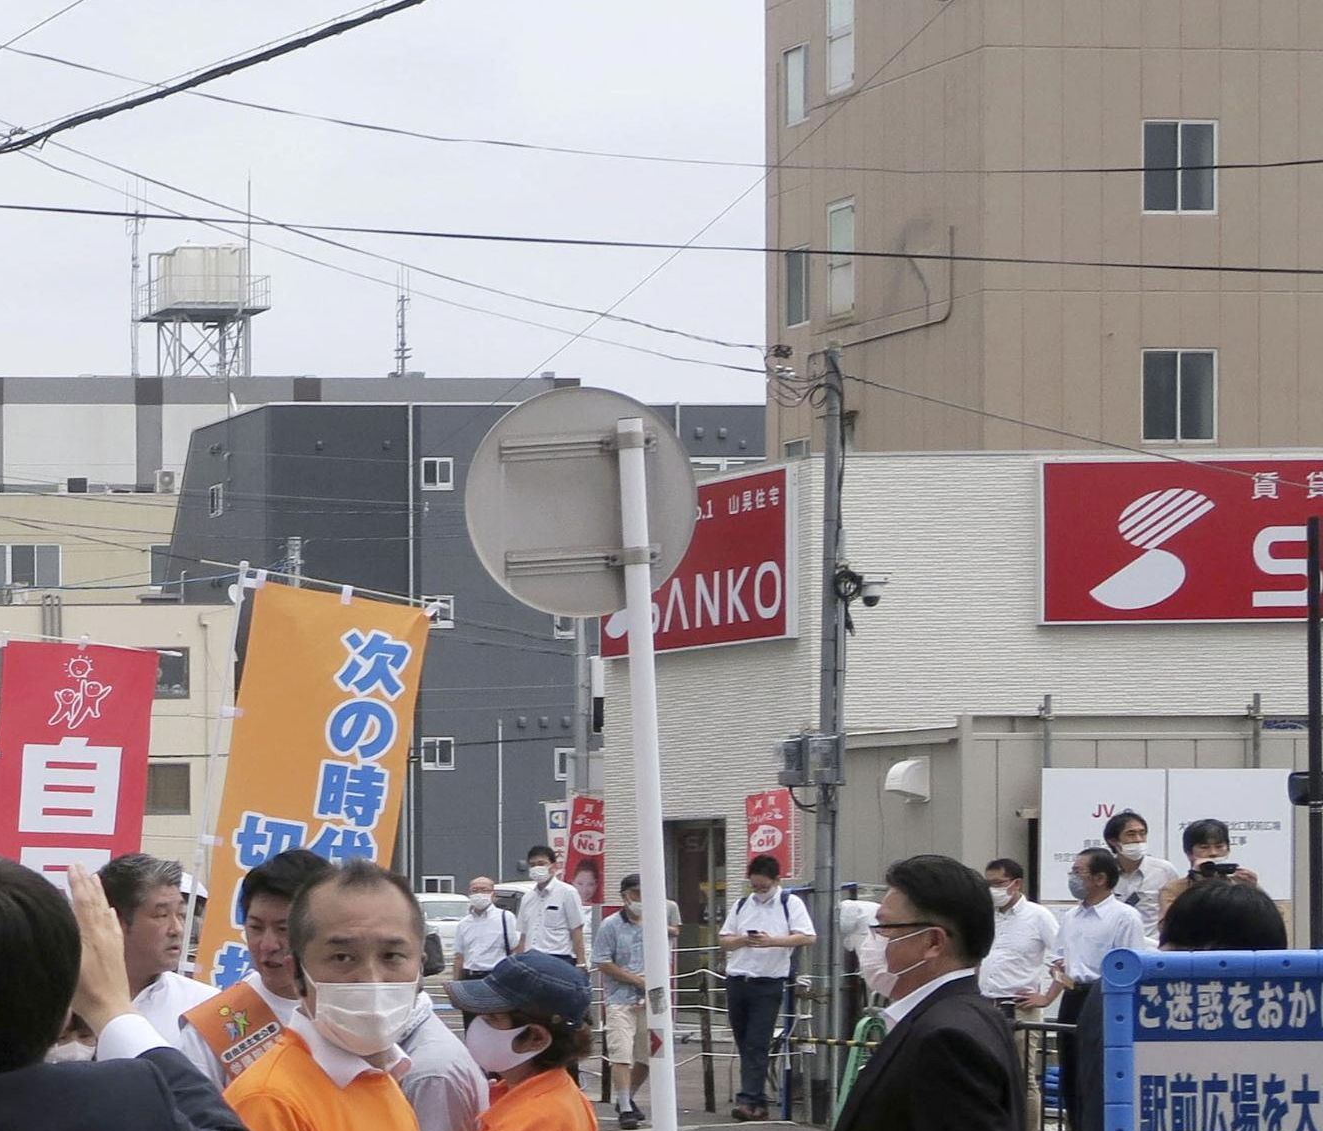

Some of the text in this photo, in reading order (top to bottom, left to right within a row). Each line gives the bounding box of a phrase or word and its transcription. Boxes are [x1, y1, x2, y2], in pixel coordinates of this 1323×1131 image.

[1252, 525, 1308, 607] S
[1092, 804, 1115, 818] JV
[577, 838, 604, 852] No.1
[1138, 981, 1323, 1030] ご迷惑をおか
